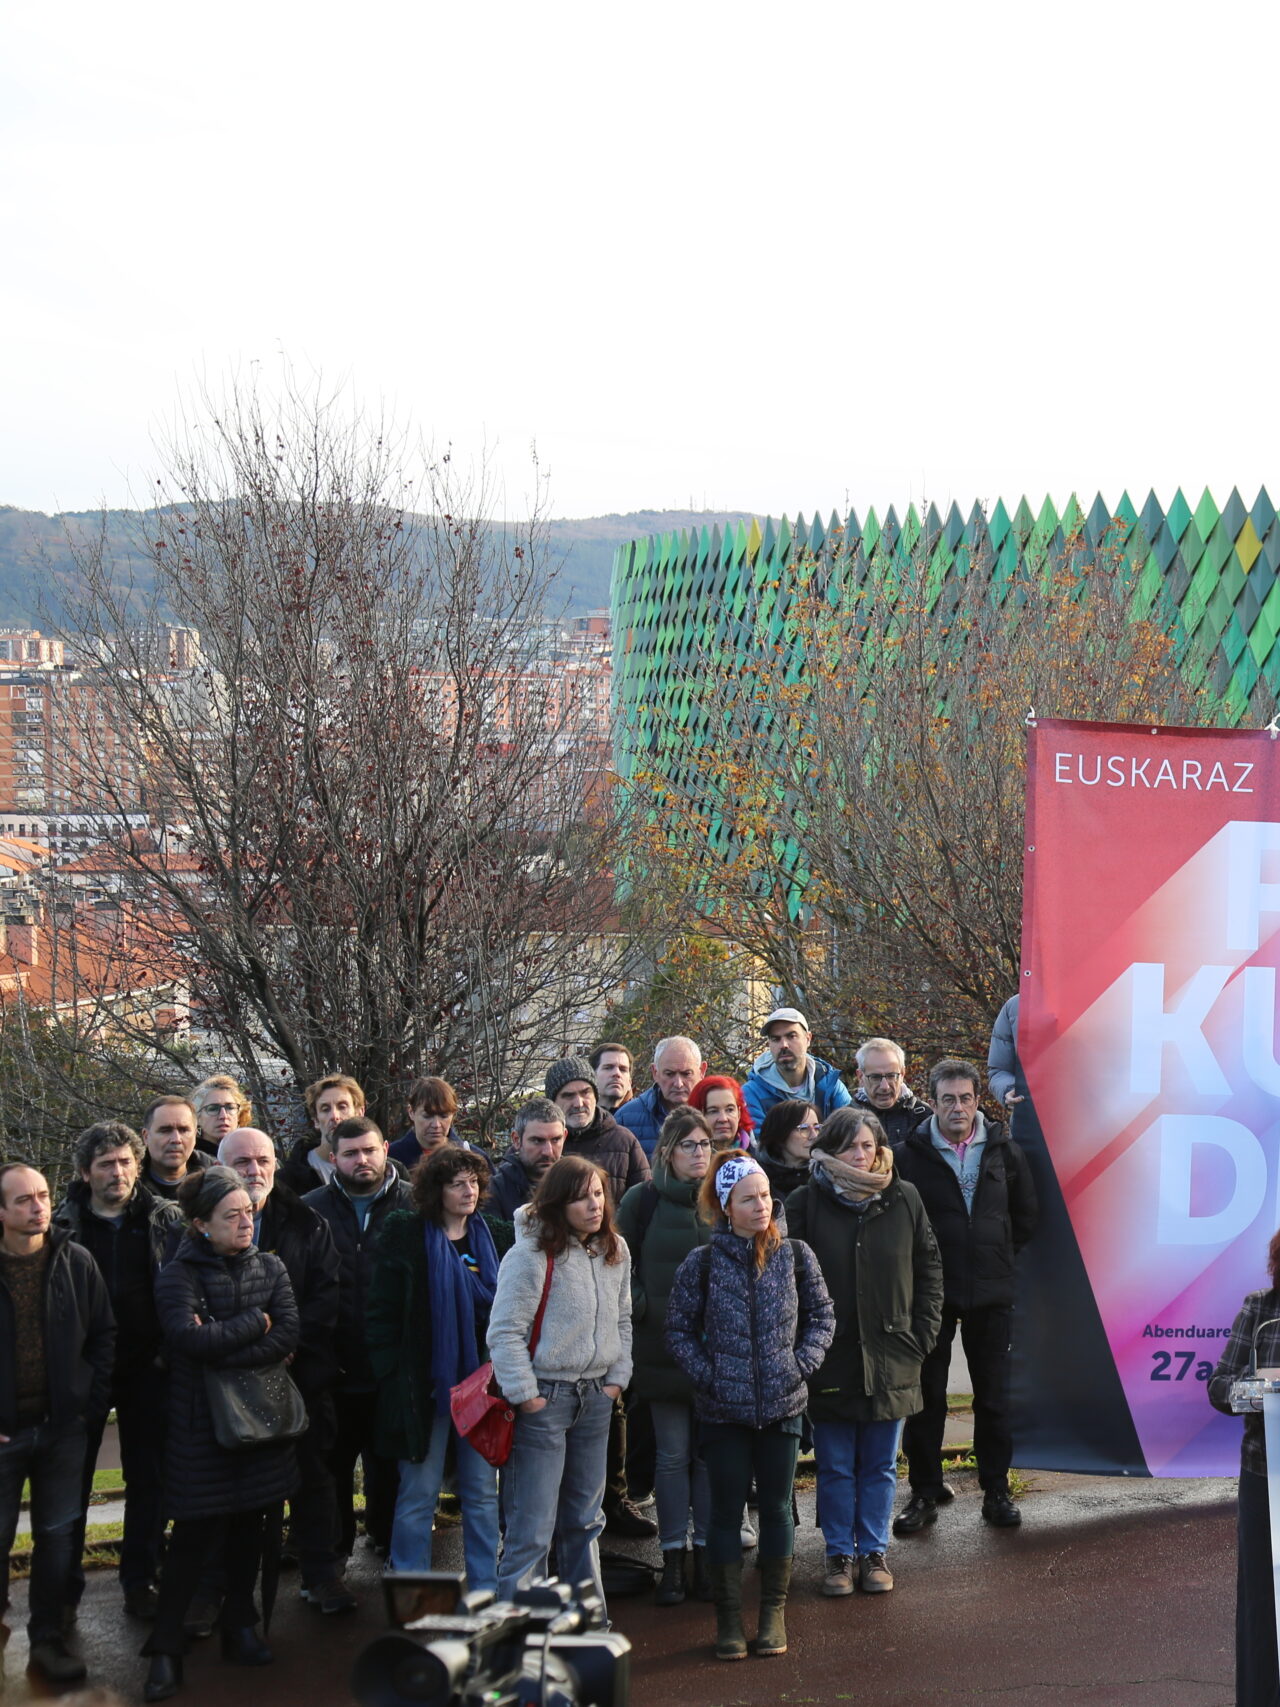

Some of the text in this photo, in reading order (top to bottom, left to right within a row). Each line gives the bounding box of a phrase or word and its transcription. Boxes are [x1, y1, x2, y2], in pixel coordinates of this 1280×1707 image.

[1055, 752, 1254, 794] EUSKARAZ
[1142, 1324, 1232, 1338] Abenduare
[1150, 1350, 1214, 1381] 27a
